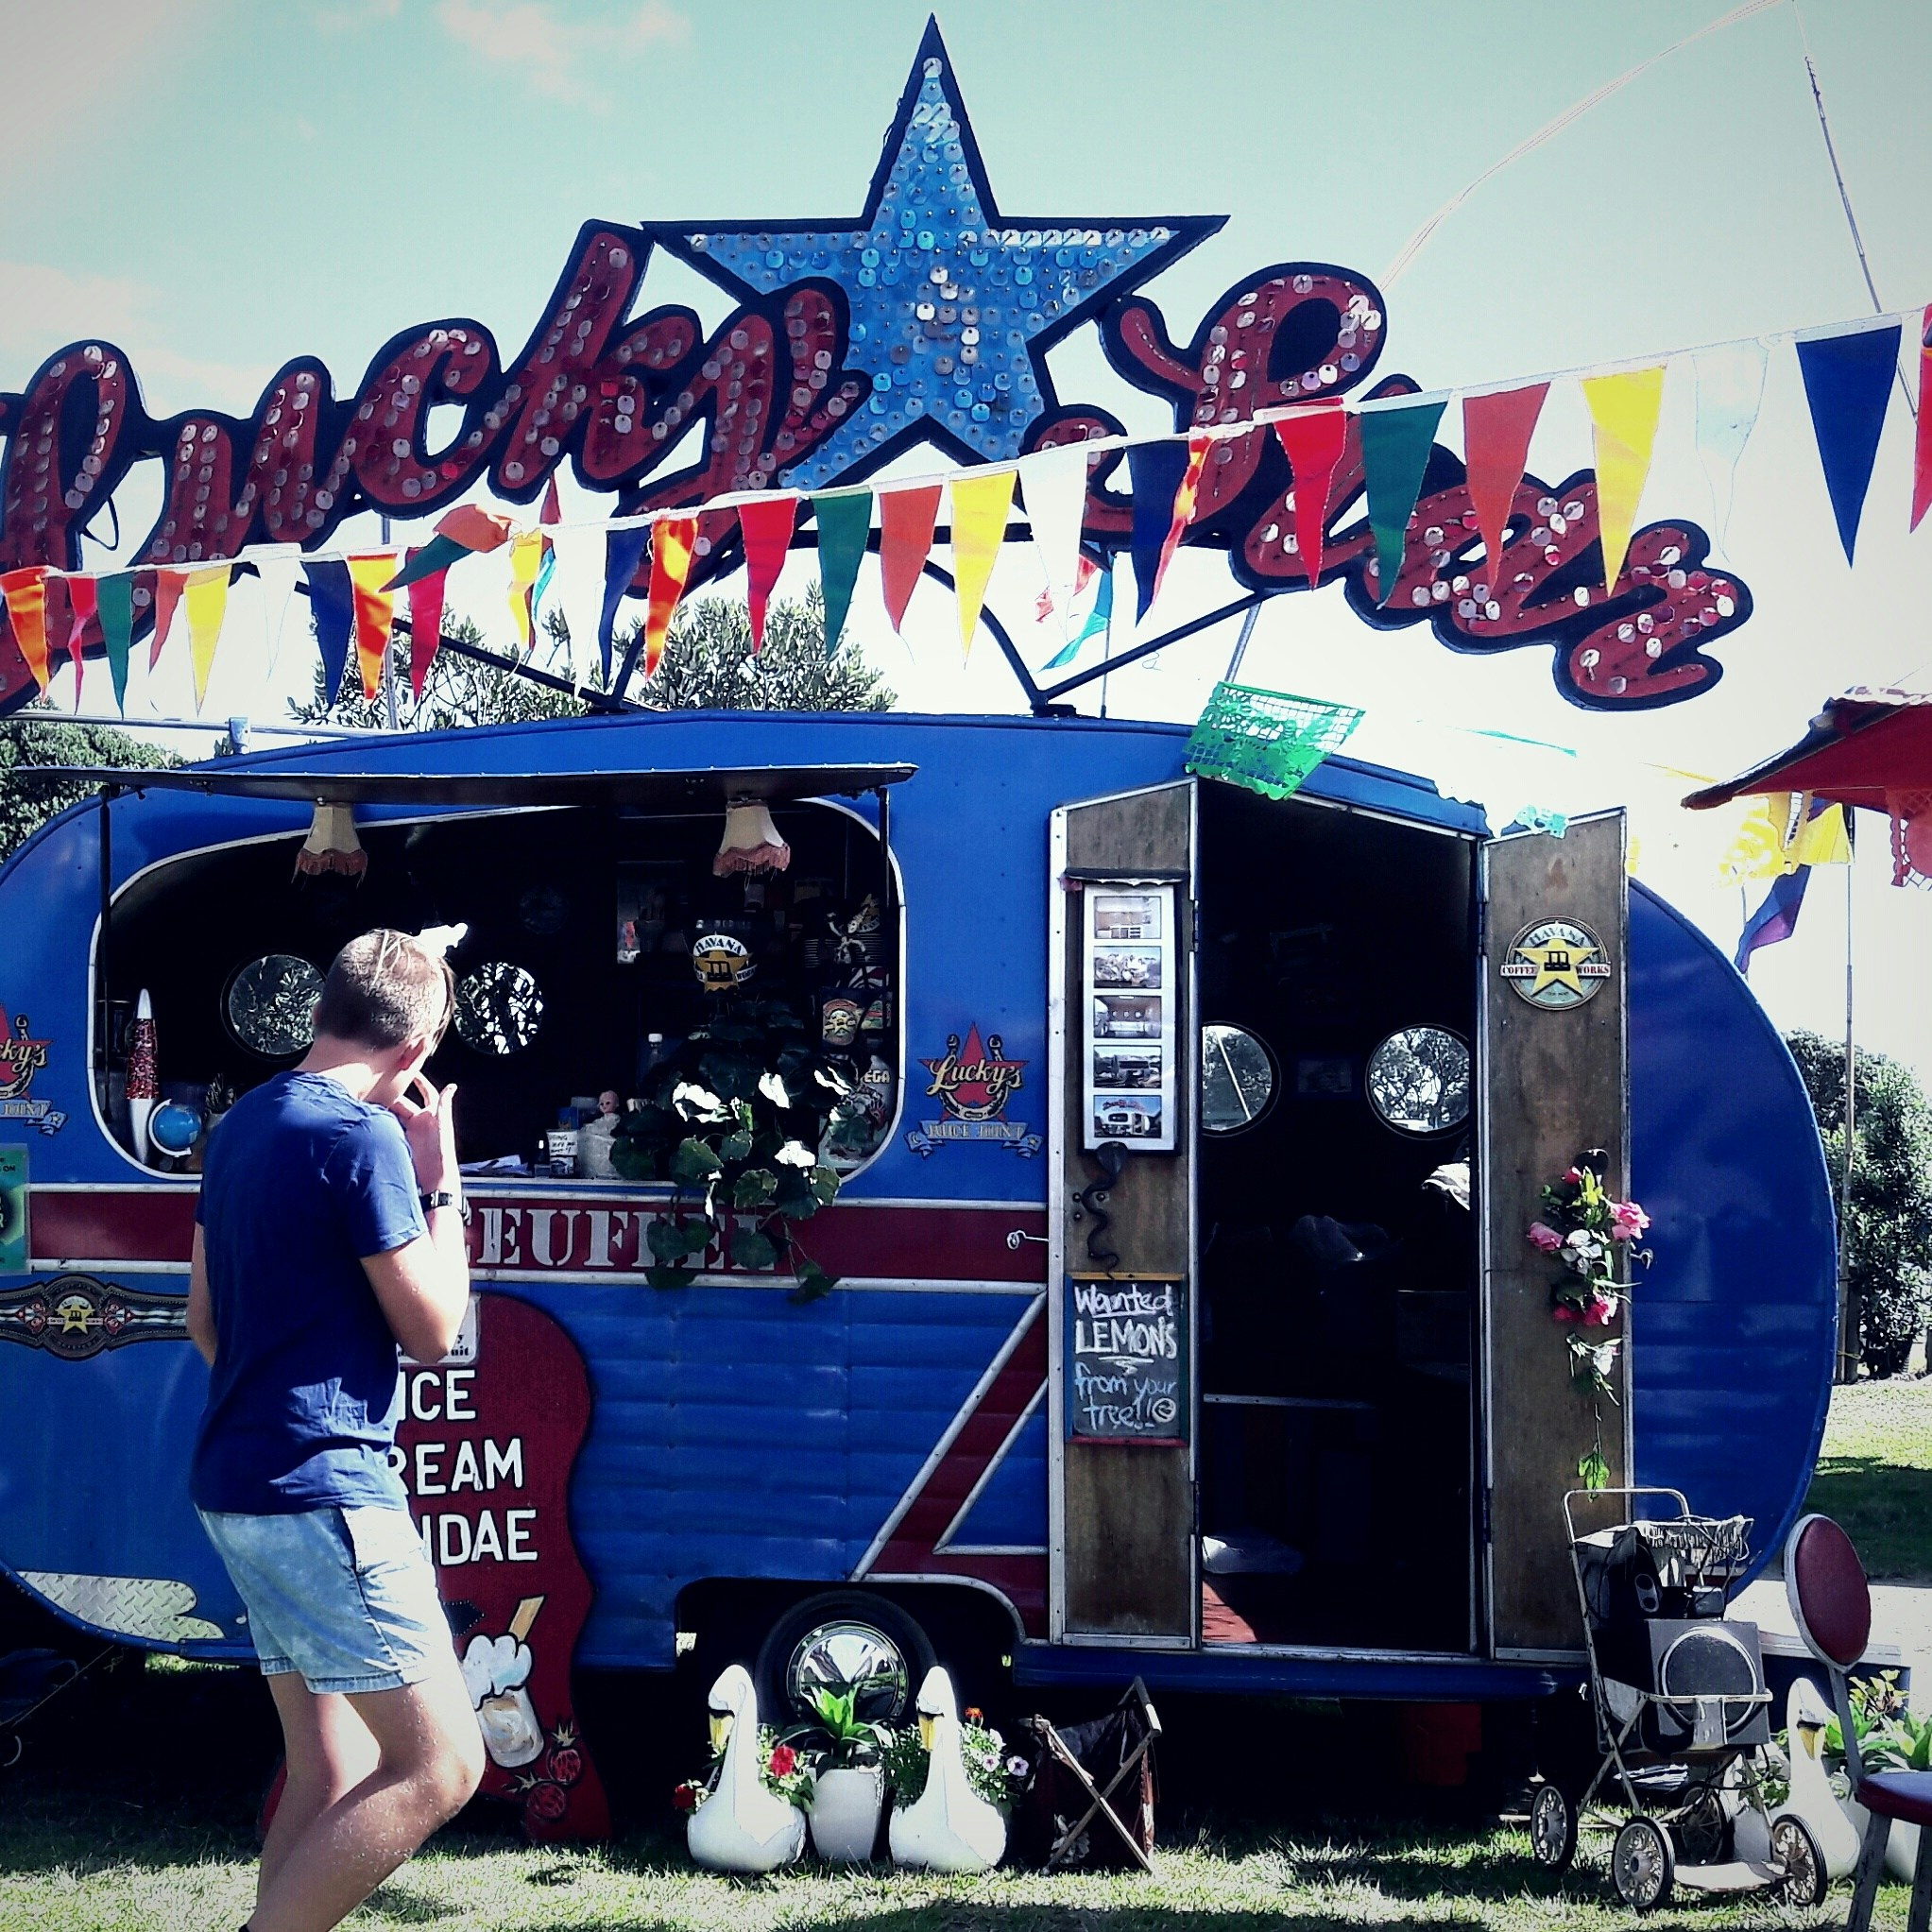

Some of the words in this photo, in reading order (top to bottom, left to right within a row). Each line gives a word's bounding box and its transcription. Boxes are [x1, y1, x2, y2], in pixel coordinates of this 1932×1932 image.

[694, 937, 742, 954] HAVANA
[1529, 927, 1585, 946] HAVANA
[926, 1054, 1022, 1096] Lucky's
[1074, 1283, 1173, 1317] Wanted
[1075, 1316, 1177, 1360] LEMONS
[399, 1369, 477, 1422] ICE
[1074, 1360, 1128, 1401] from
[1132, 1376, 1177, 1407] your
